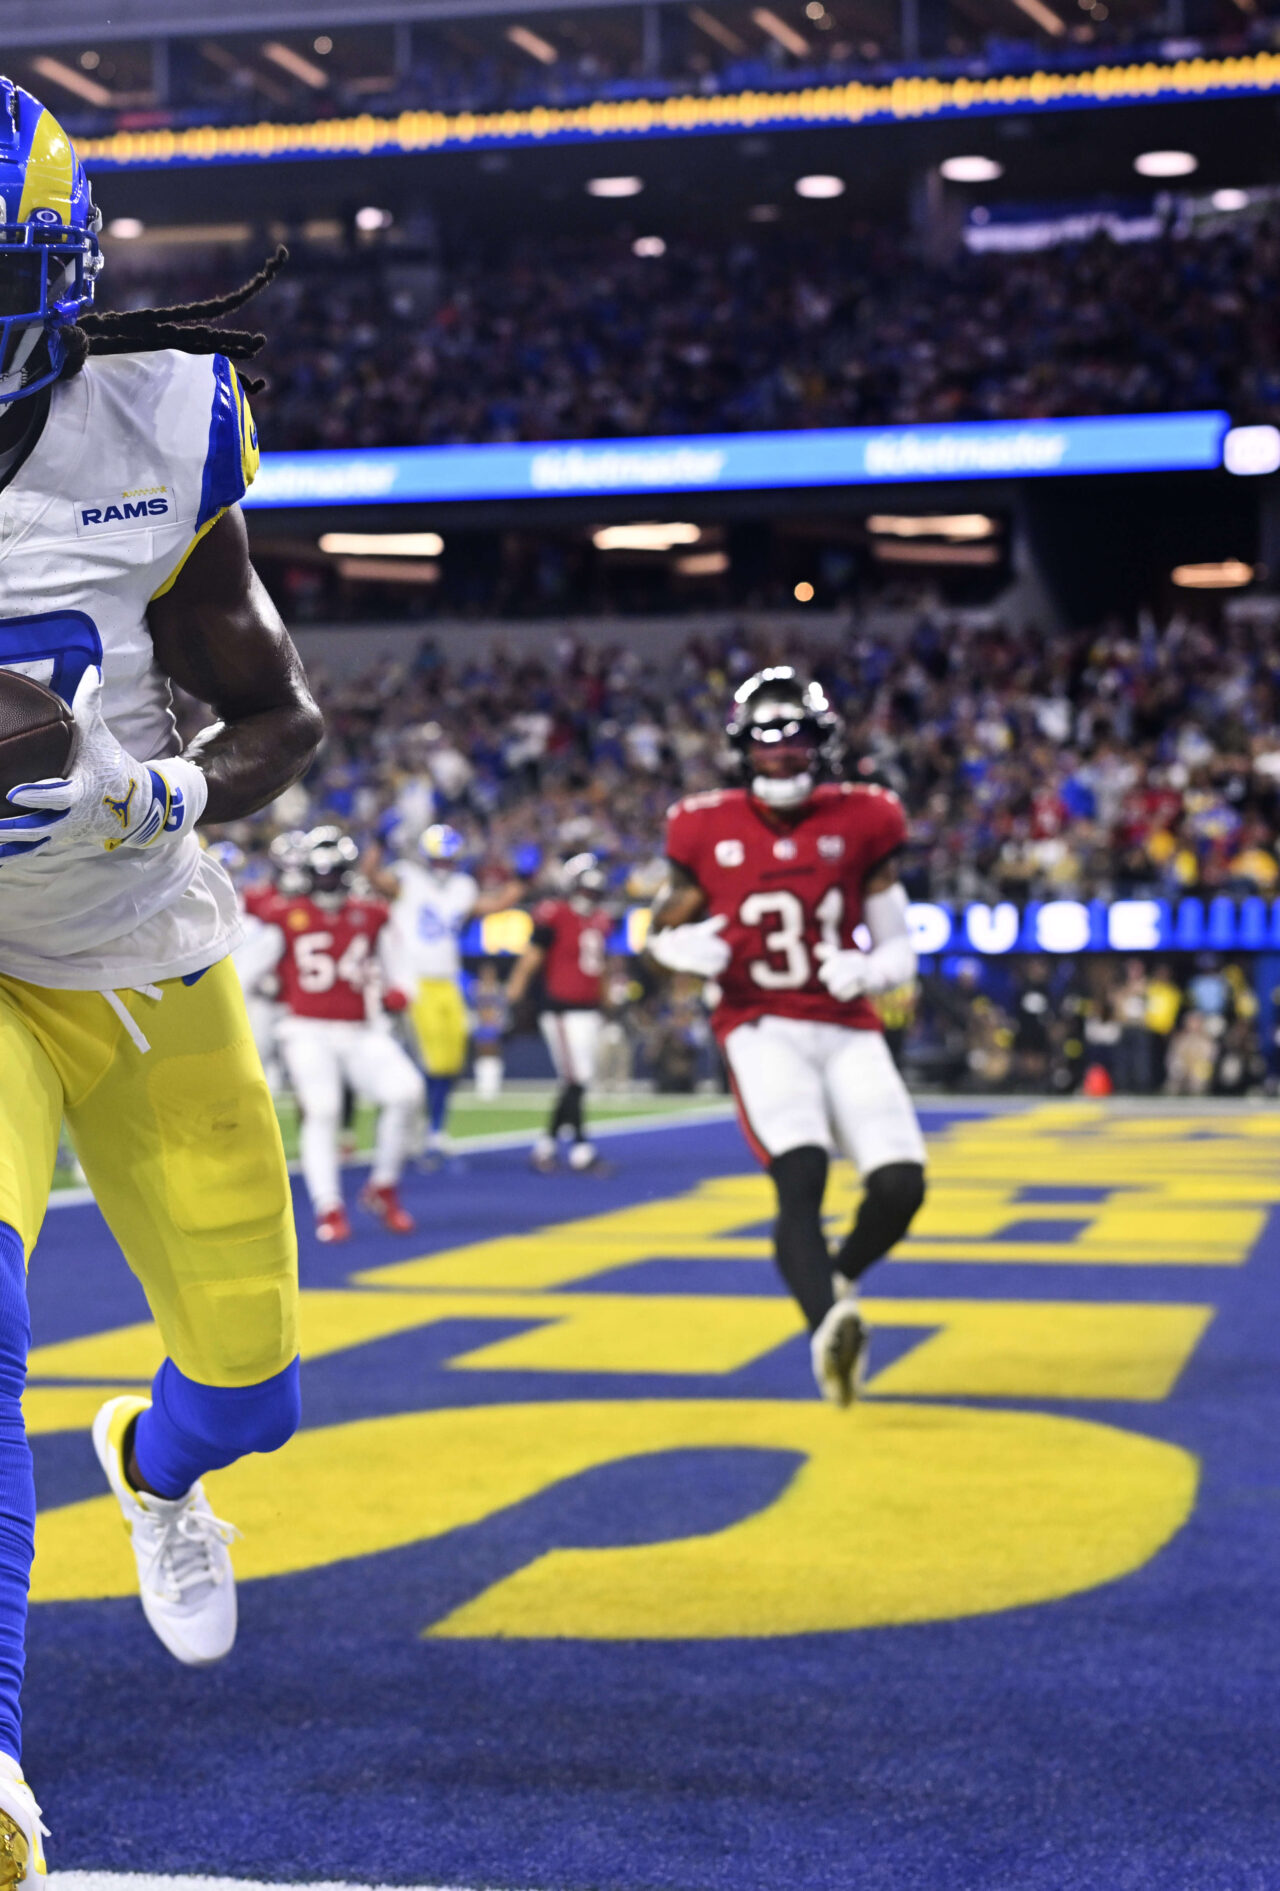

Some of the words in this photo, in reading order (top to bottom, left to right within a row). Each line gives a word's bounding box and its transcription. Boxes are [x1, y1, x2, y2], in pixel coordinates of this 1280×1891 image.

[81, 498, 169, 526] RAMS
[739, 887, 843, 989] 31
[902, 899, 1162, 955] OUSE
[293, 931, 372, 995] 54
